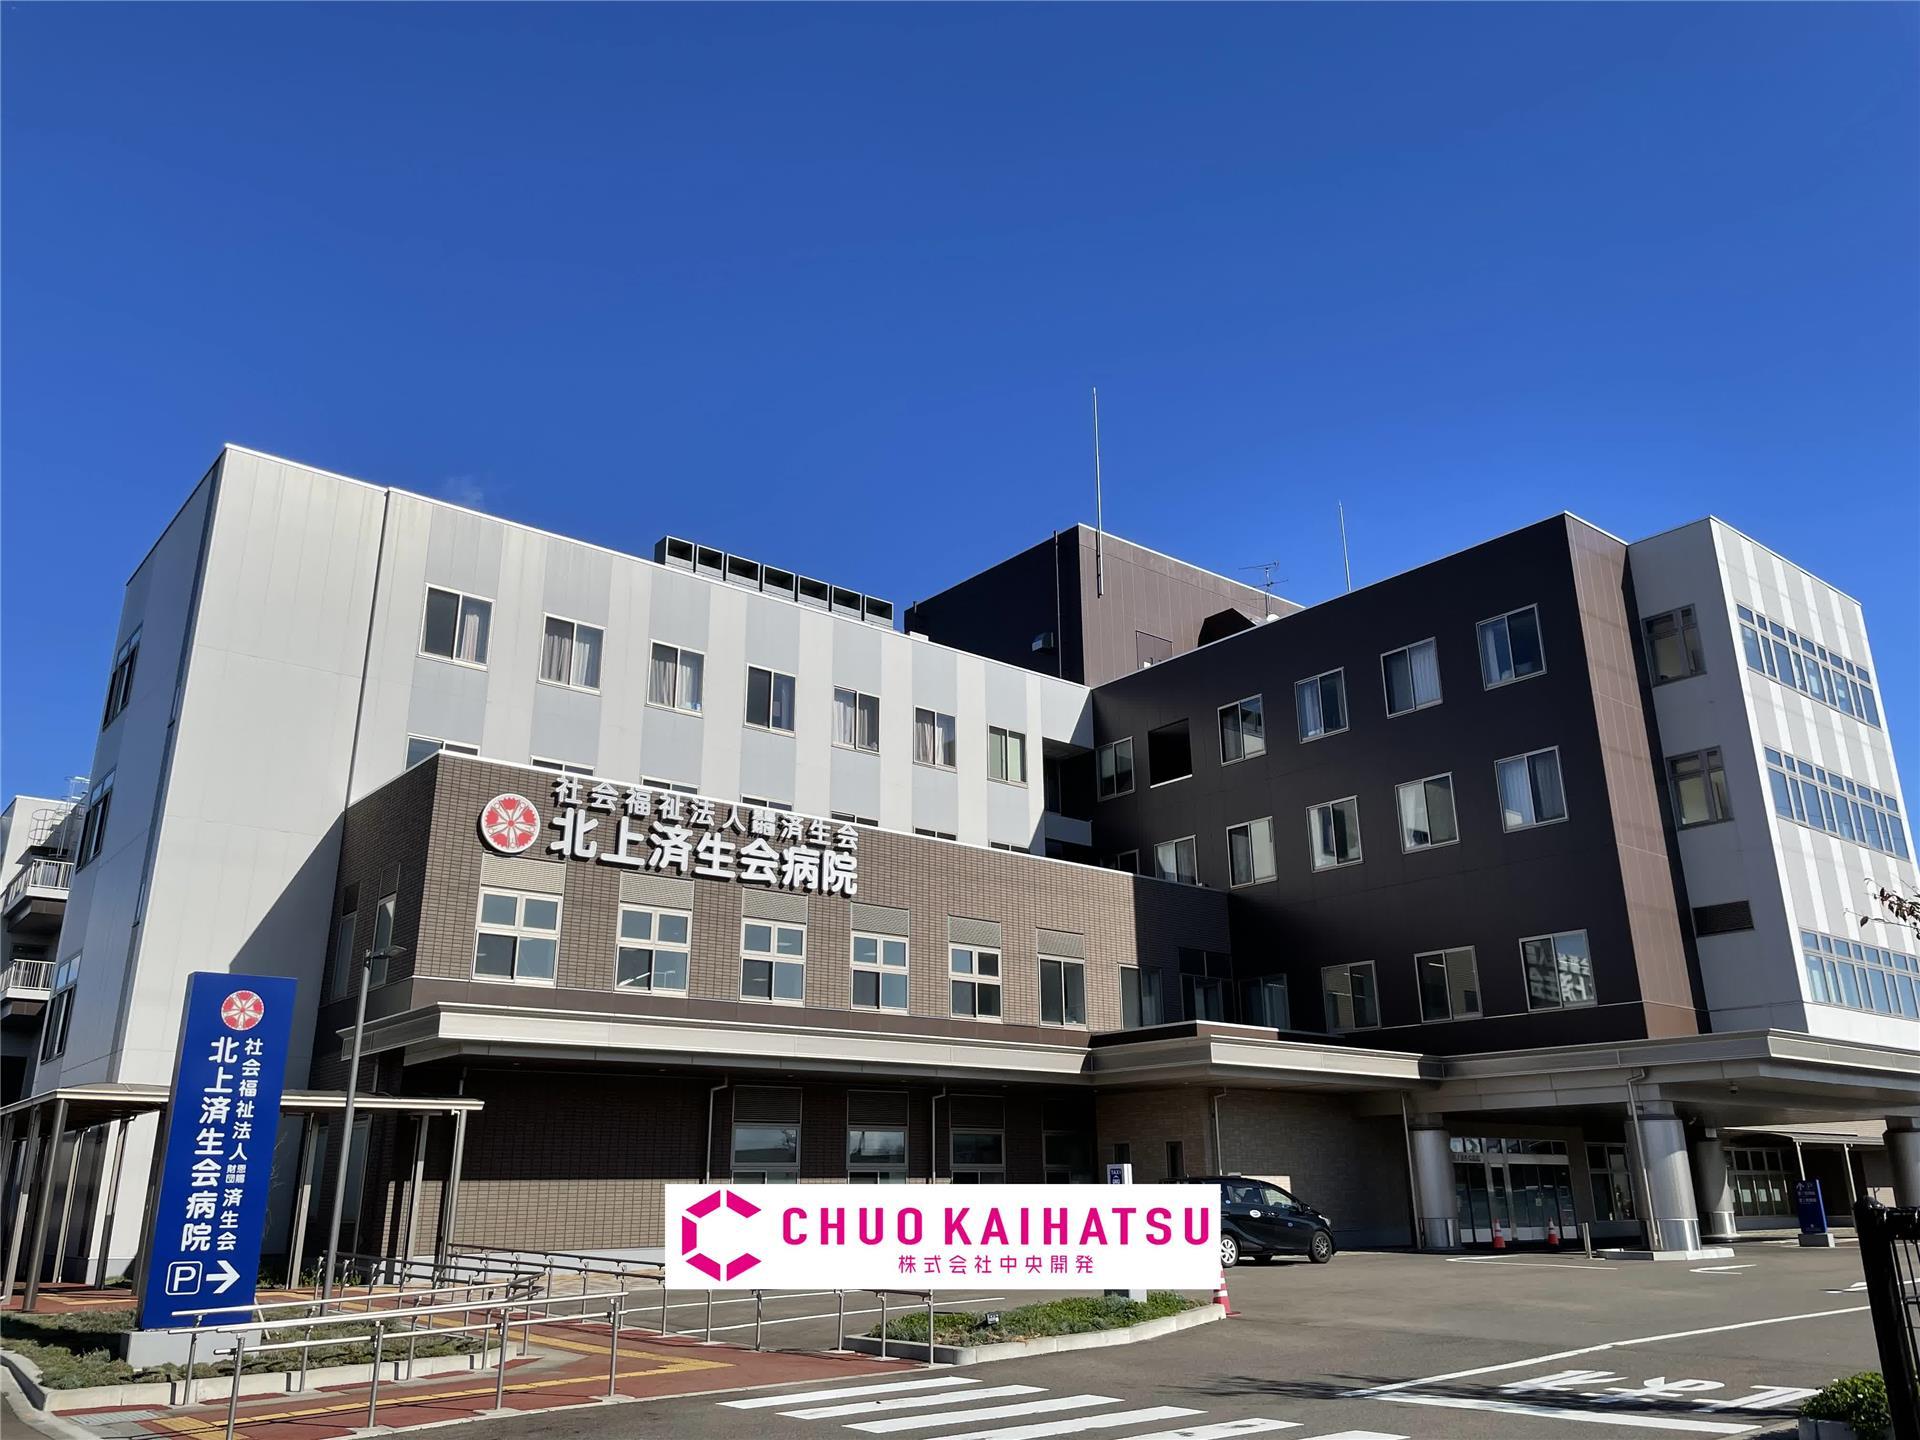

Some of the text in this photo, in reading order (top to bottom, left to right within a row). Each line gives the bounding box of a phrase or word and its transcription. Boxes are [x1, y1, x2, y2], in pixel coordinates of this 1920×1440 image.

[550, 808, 859, 895] 北上済生会病院
[180, 1036, 240, 1252] 北上済生会病院
[172, 1266, 197, 1292] P
